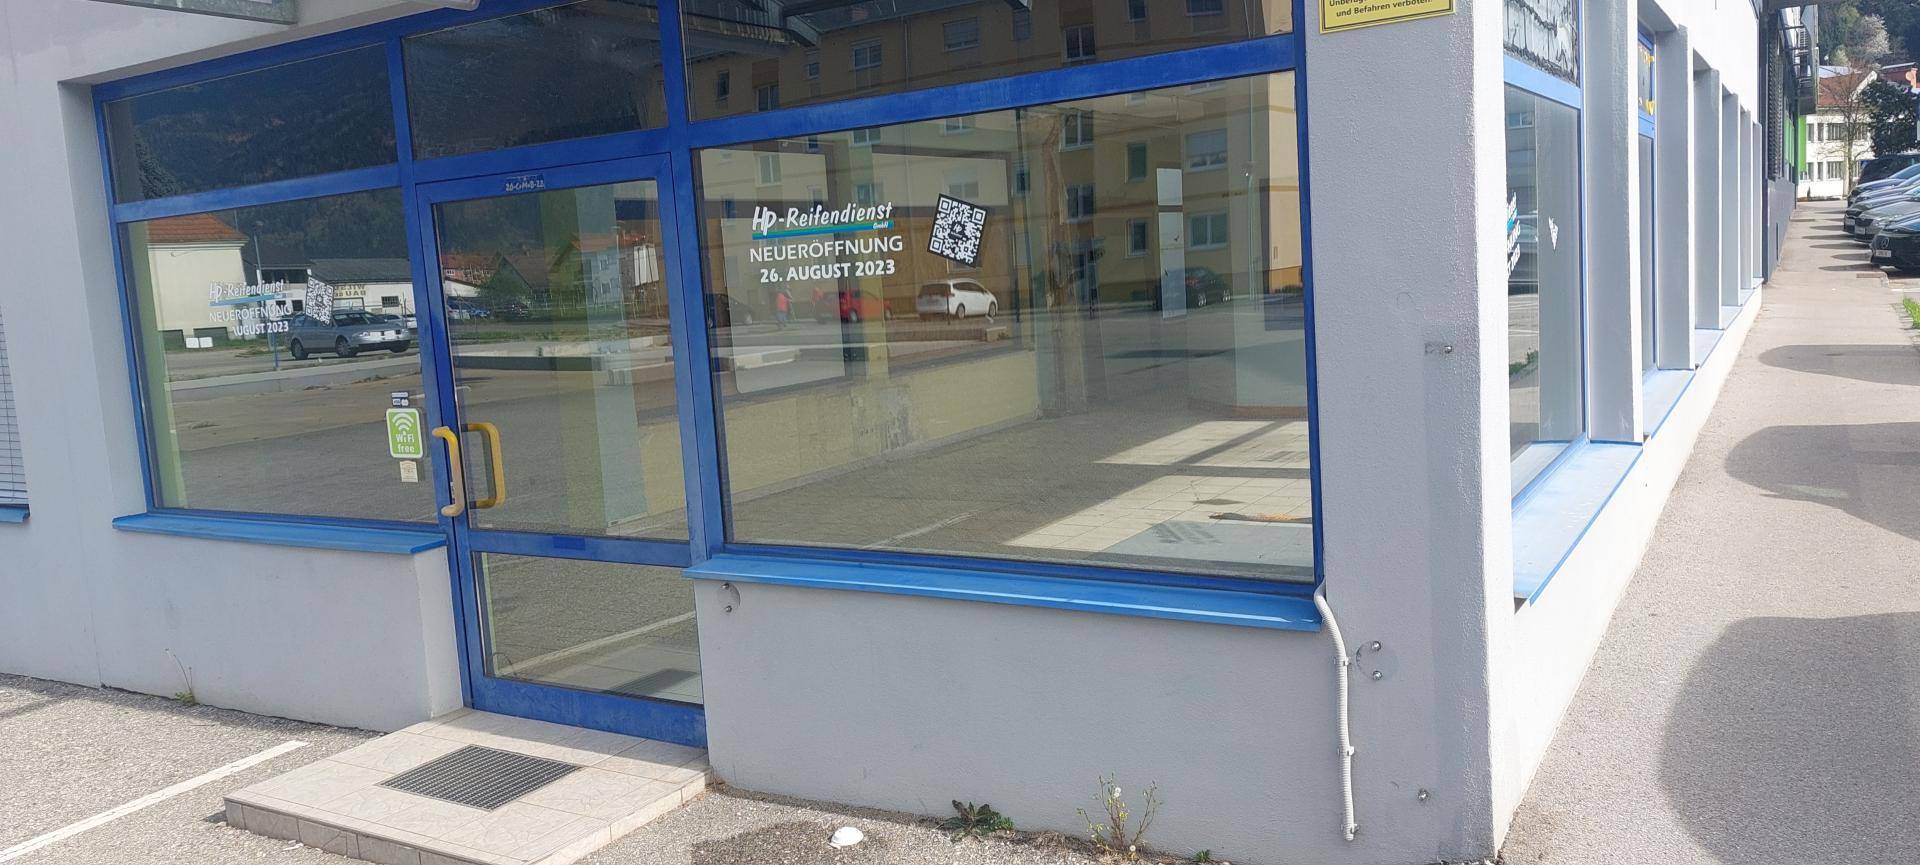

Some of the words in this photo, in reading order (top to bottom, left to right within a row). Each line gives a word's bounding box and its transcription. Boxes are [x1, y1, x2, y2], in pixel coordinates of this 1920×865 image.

[1336, 9, 1352, 17] und
[1354, 3, 1391, 15] Befahren
[752, 202, 893, 236] Hp-Reifendienst
[749, 235, 904, 263] NEUERÖFFNUNG
[760, 268, 783, 283] 26.
[786, 262, 852, 282] AUGUST
[855, 259, 896, 277] 2023
[266, 321, 290, 333] 2023
[397, 443, 415, 453] free
